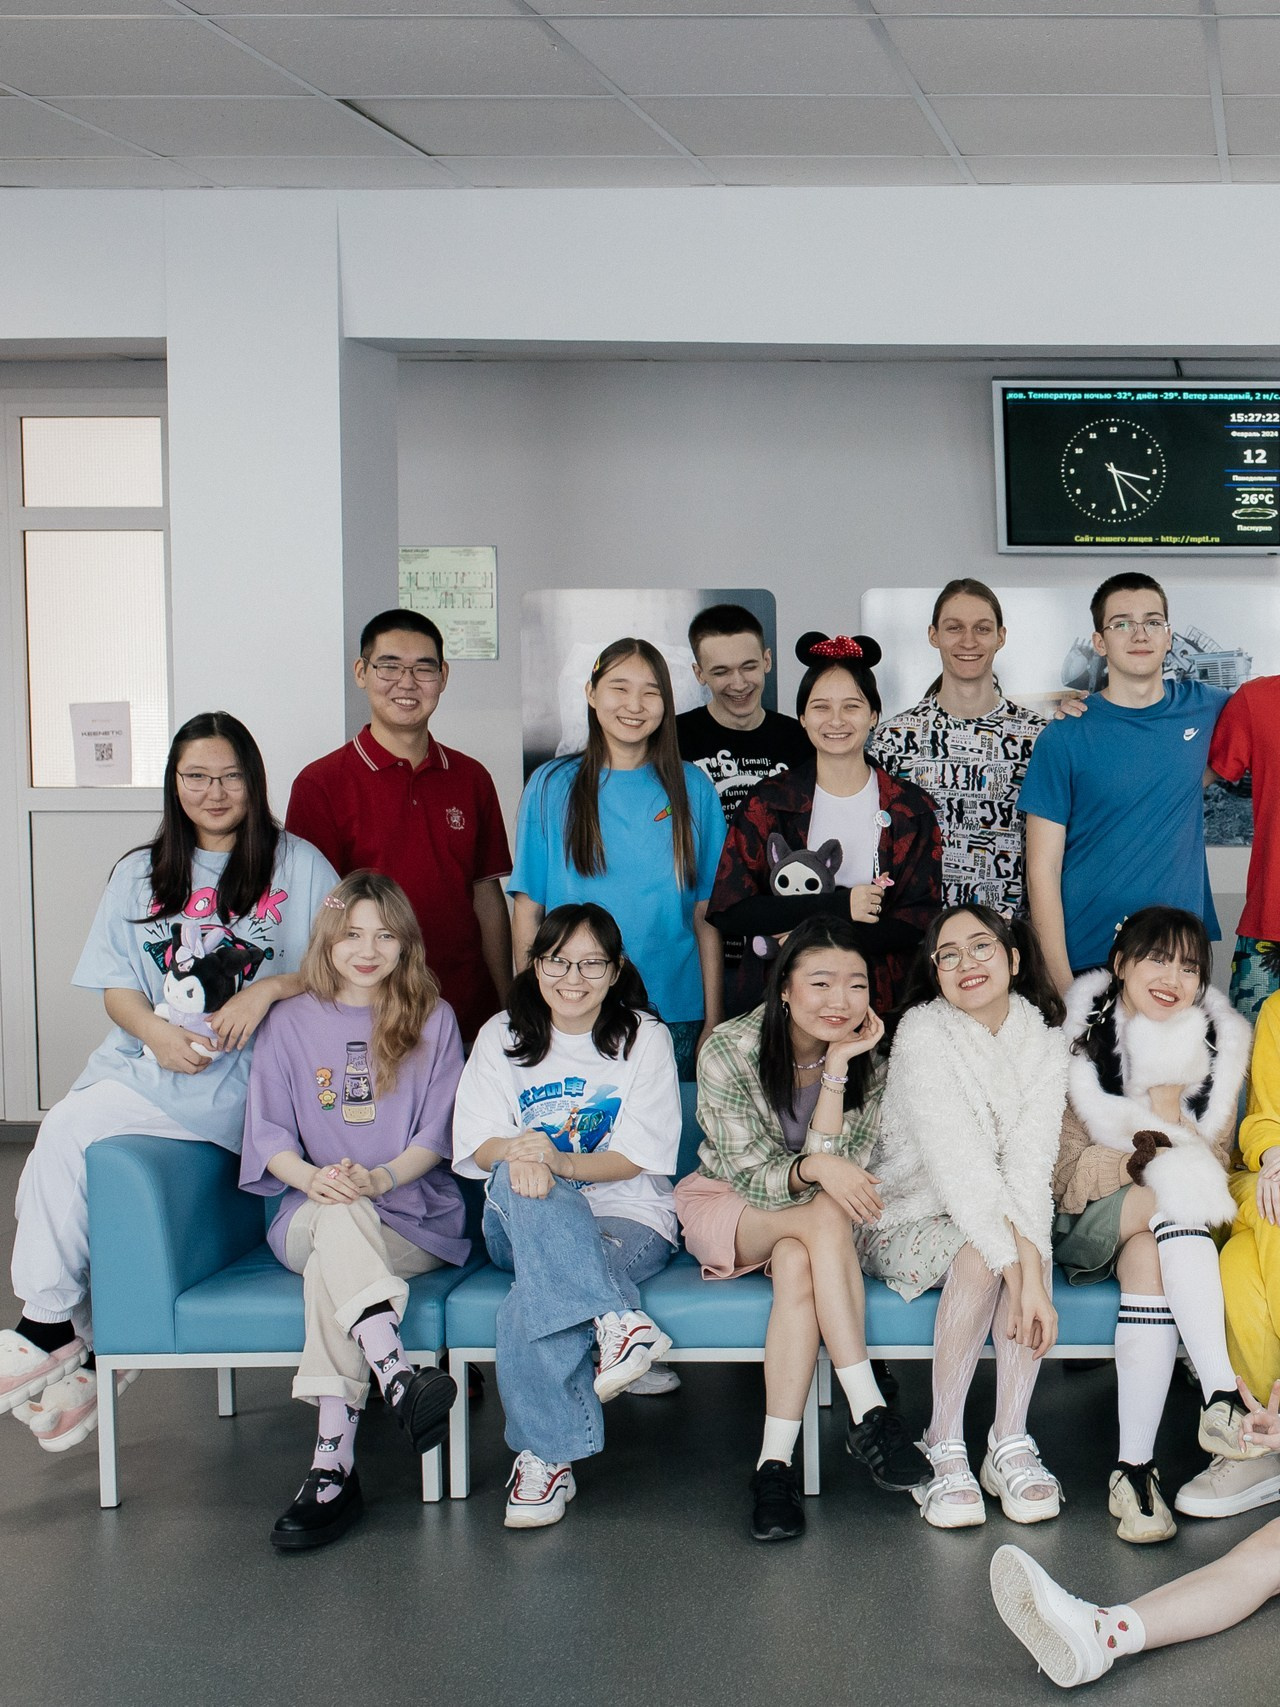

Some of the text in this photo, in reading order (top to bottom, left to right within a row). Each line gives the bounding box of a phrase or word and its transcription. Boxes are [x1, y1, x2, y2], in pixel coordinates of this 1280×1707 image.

[1028, 391, 1082, 400] Температура
[1084, 392, 1112, 400] ночью
[1136, 391, 1158, 400] днём
[1183, 391, 1208, 400] Ветер
[1209, 391, 1253, 401] западный,
[1255, 392, 1261, 400] 2
[1263, 392, 1280, 400] м/с.
[1230, 413, 1280, 422] 15:27:22
[1243, 449, 1267, 464] 12
[1074, 534, 1094, 543] Сайт
[933, 719, 968, 732] GAME
[754, 769, 769, 779] you
